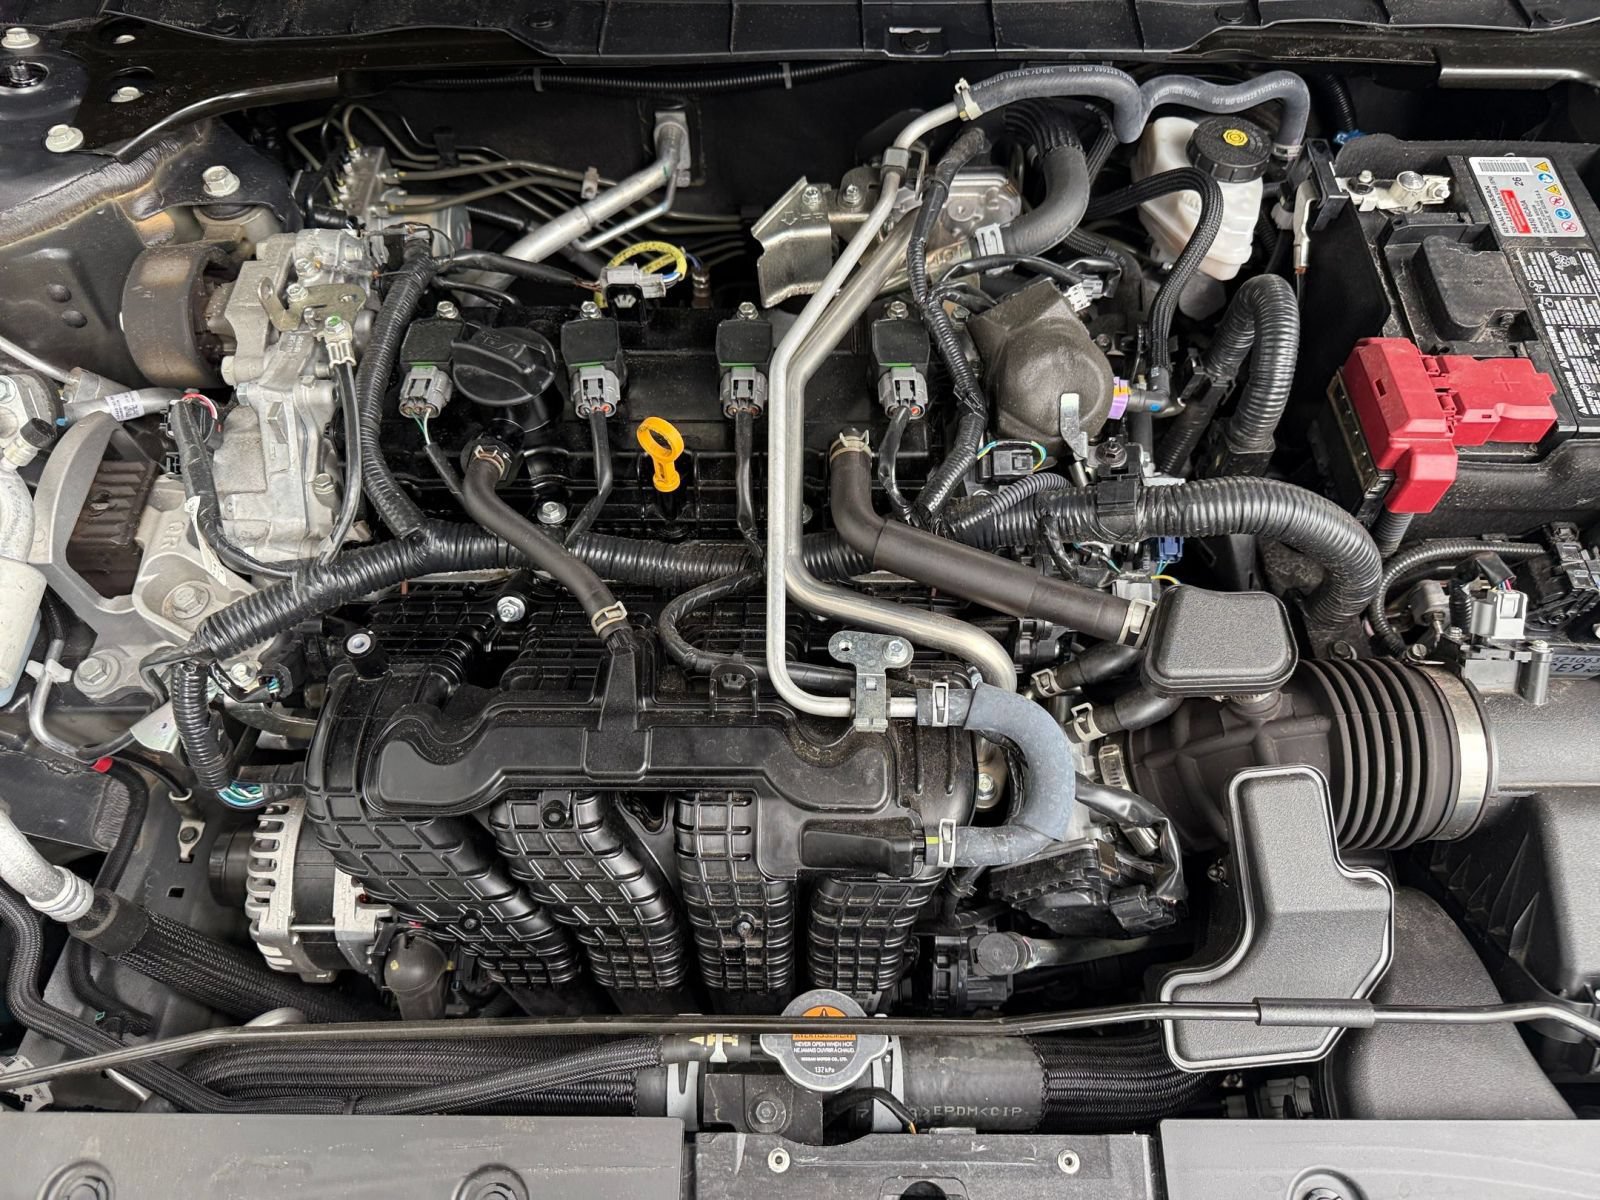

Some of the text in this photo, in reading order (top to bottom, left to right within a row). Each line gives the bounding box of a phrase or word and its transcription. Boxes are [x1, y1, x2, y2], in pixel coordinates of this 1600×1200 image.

[1510, 176, 1524, 186] 26
[1483, 185, 1510, 233] RENAULT NISSAN
[1551, 663, 1585, 672] E9
